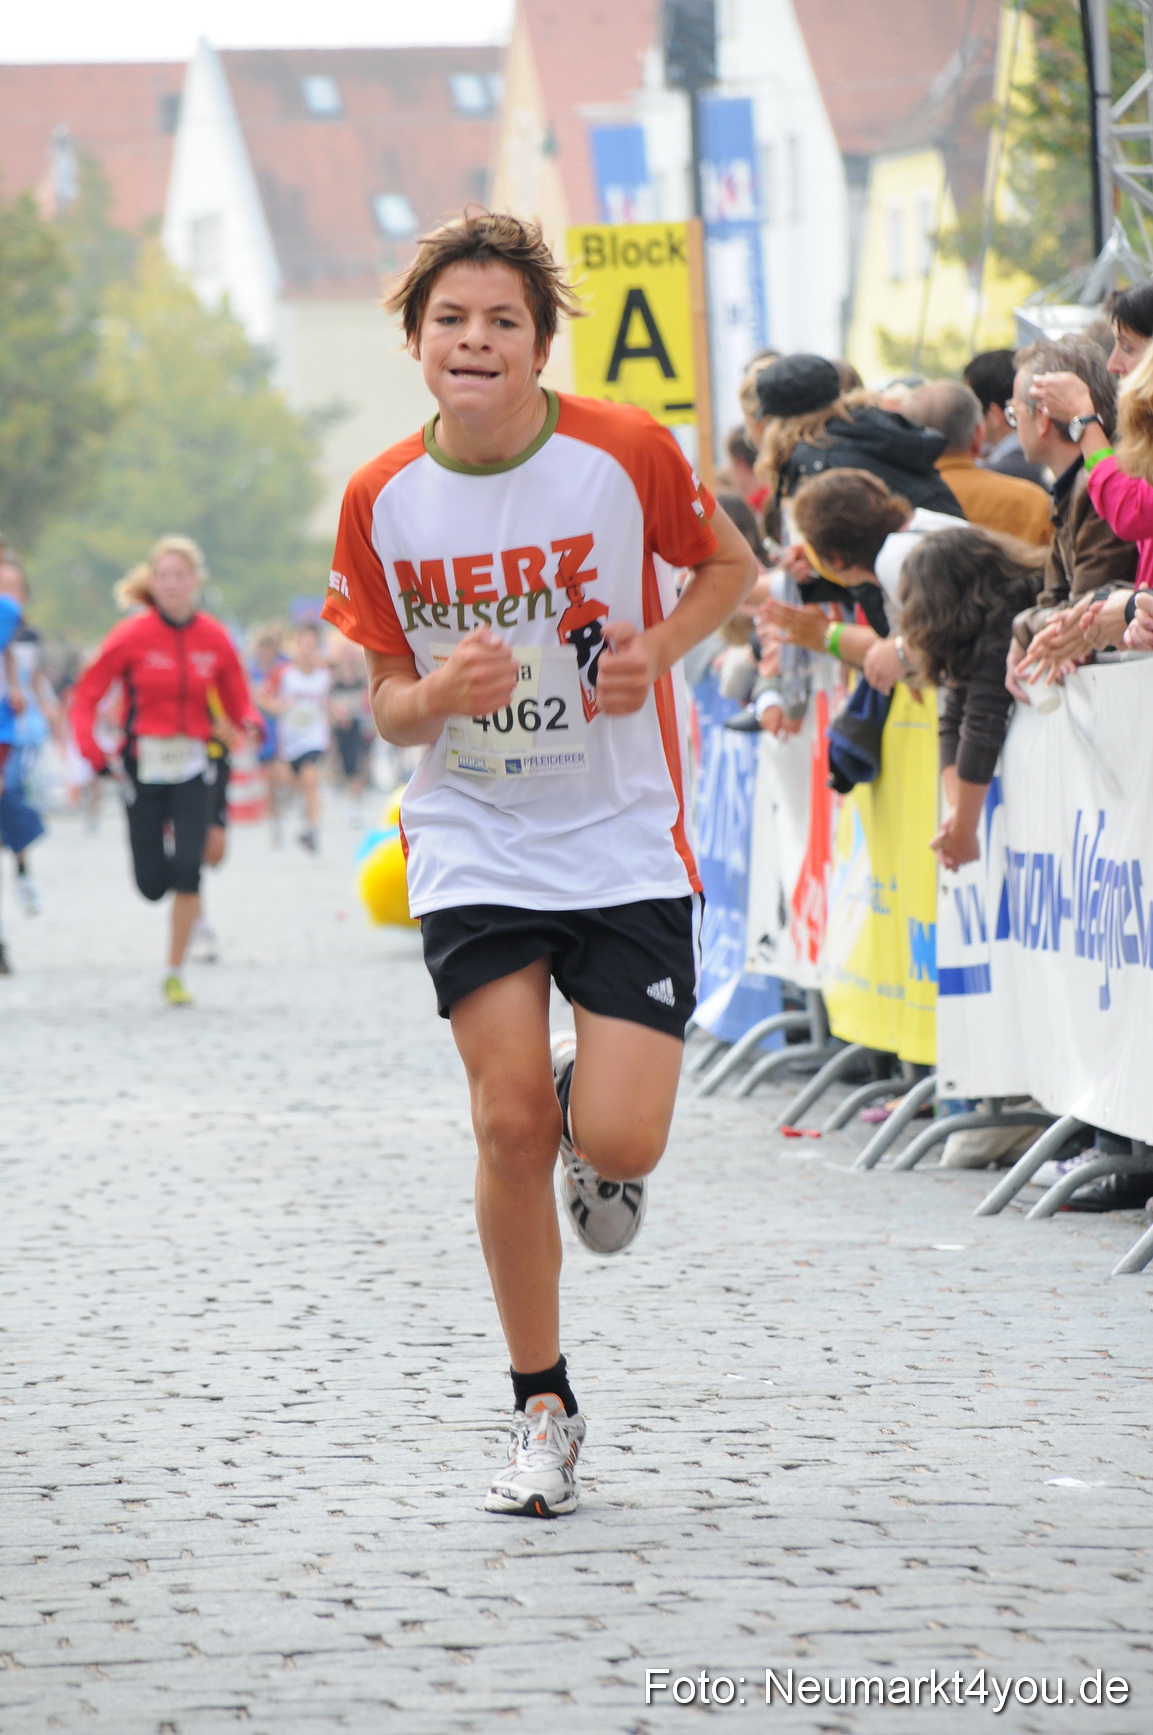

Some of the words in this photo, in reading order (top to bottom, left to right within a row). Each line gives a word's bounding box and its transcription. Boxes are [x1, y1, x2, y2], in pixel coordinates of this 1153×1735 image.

[581, 231, 687, 270] Block
[605, 287, 677, 383] A
[393, 533, 598, 607] MERZ
[398, 587, 557, 633] Reisen
[523, 753, 585, 768] PFLEIDERER
